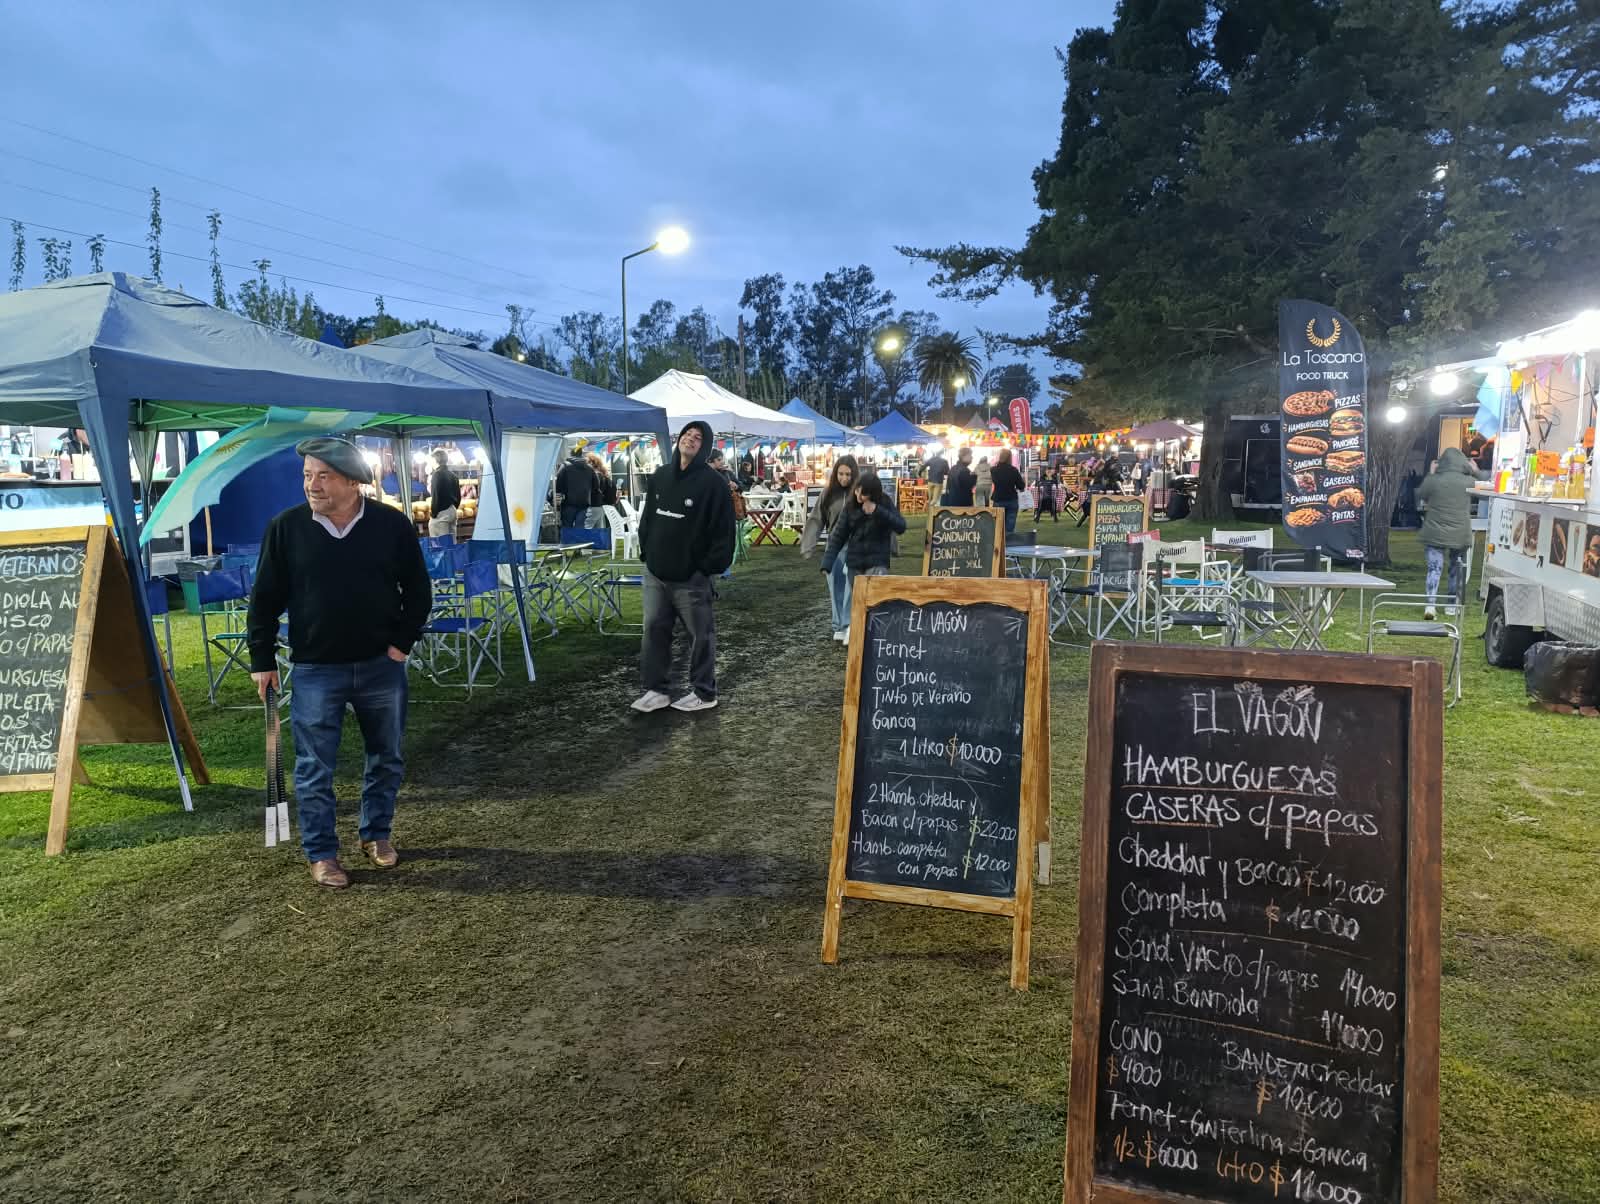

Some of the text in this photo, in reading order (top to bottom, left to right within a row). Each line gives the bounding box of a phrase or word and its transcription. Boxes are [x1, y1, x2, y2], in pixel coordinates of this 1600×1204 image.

[1283, 349, 1363, 366] La Toscana
[1296, 371, 1349, 382] FOOD TRUCK
[1334, 394, 1361, 409] PIZZAS
[1288, 419, 1329, 433] HAMBURGUESAS
[1332, 436, 1360, 450] PANCHOS
[1293, 458, 1323, 471] SANDWICH
[1323, 475, 1355, 488] GASEOSA
[1290, 494, 1328, 505] EMPANADAS
[1331, 510, 1356, 522] FRITAS
[933, 531, 981, 545] SANDWICH
[905, 607, 923, 633] EL
[873, 636, 927, 660] Fernet
[898, 662, 937, 687] tonic
[912, 694, 925, 706] DE
[928, 690, 972, 705] Verano
[871, 711, 916, 731] Gancia
[1193, 690, 1230, 734] EL
[899, 738, 907, 758] 1
[867, 783, 878, 804] 2
[969, 797, 978, 816] y
[861, 809, 898, 828] Bacon
[1126, 793, 1241, 827] CASERAS
[897, 841, 948, 862] completa
[923, 864, 959, 882] papas
[1119, 832, 1212, 877] Cheddar
[1218, 860, 1228, 899] y
[1235, 858, 1301, 887] Bacon
[1121, 881, 1227, 928] Completa
[1109, 1019, 1162, 1055] CONO
[1105, 1089, 1177, 1132] Fernet
